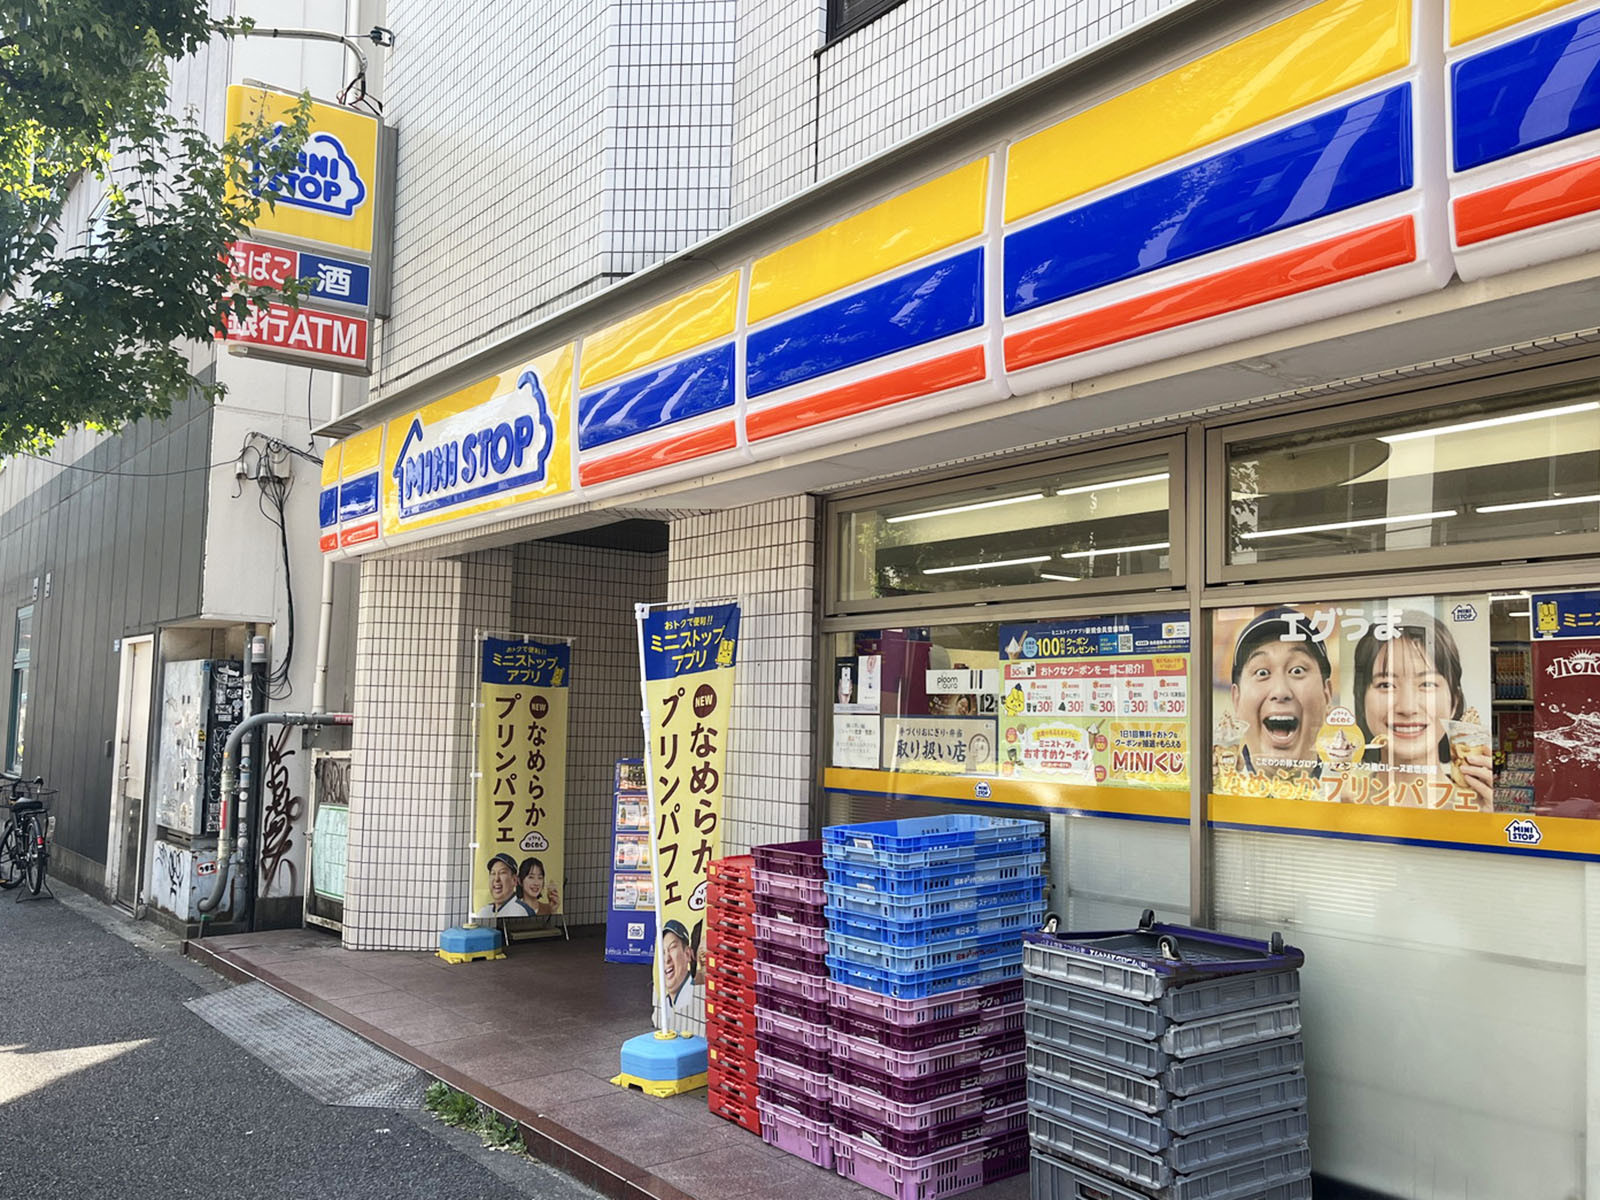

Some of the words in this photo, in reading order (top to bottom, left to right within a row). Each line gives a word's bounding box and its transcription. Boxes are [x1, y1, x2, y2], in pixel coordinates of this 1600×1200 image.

[267, 172, 342, 202] STOP
[317, 263, 353, 297] 酒
[405, 440, 458, 500] MINI
[461, 414, 534, 484] STOP
[1279, 607, 1404, 643] エグうま
[650, 624, 726, 653] ミニストップ
[1036, 637, 1060, 657] 100
[492, 653, 559, 670] ミニストップ
[671, 649, 707, 673] アプリ
[507, 669, 541, 683] アプリ
[531, 703, 547, 711] NEW
[694, 694, 714, 708] NEW
[1037, 701, 1050, 712] 30
[1068, 701, 1080, 712] 30
[1099, 701, 1113, 713] 30
[1131, 700, 1145, 712] 30
[1167, 700, 1181, 712] 30
[896, 739, 967, 762] 取り扱い店
[493, 692, 522, 843] プリンパフェ
[1113, 751, 1184, 773] MINIくじ
[525, 721, 547, 827] なめらか
[657, 687, 686, 906] プリンパフェ
[1512, 833, 1535, 841] STOP
[1513, 825, 1533, 833] MINI
[958, 996, 993, 1012] ミニストップ
[958, 1023, 993, 1038] ミニストップ
